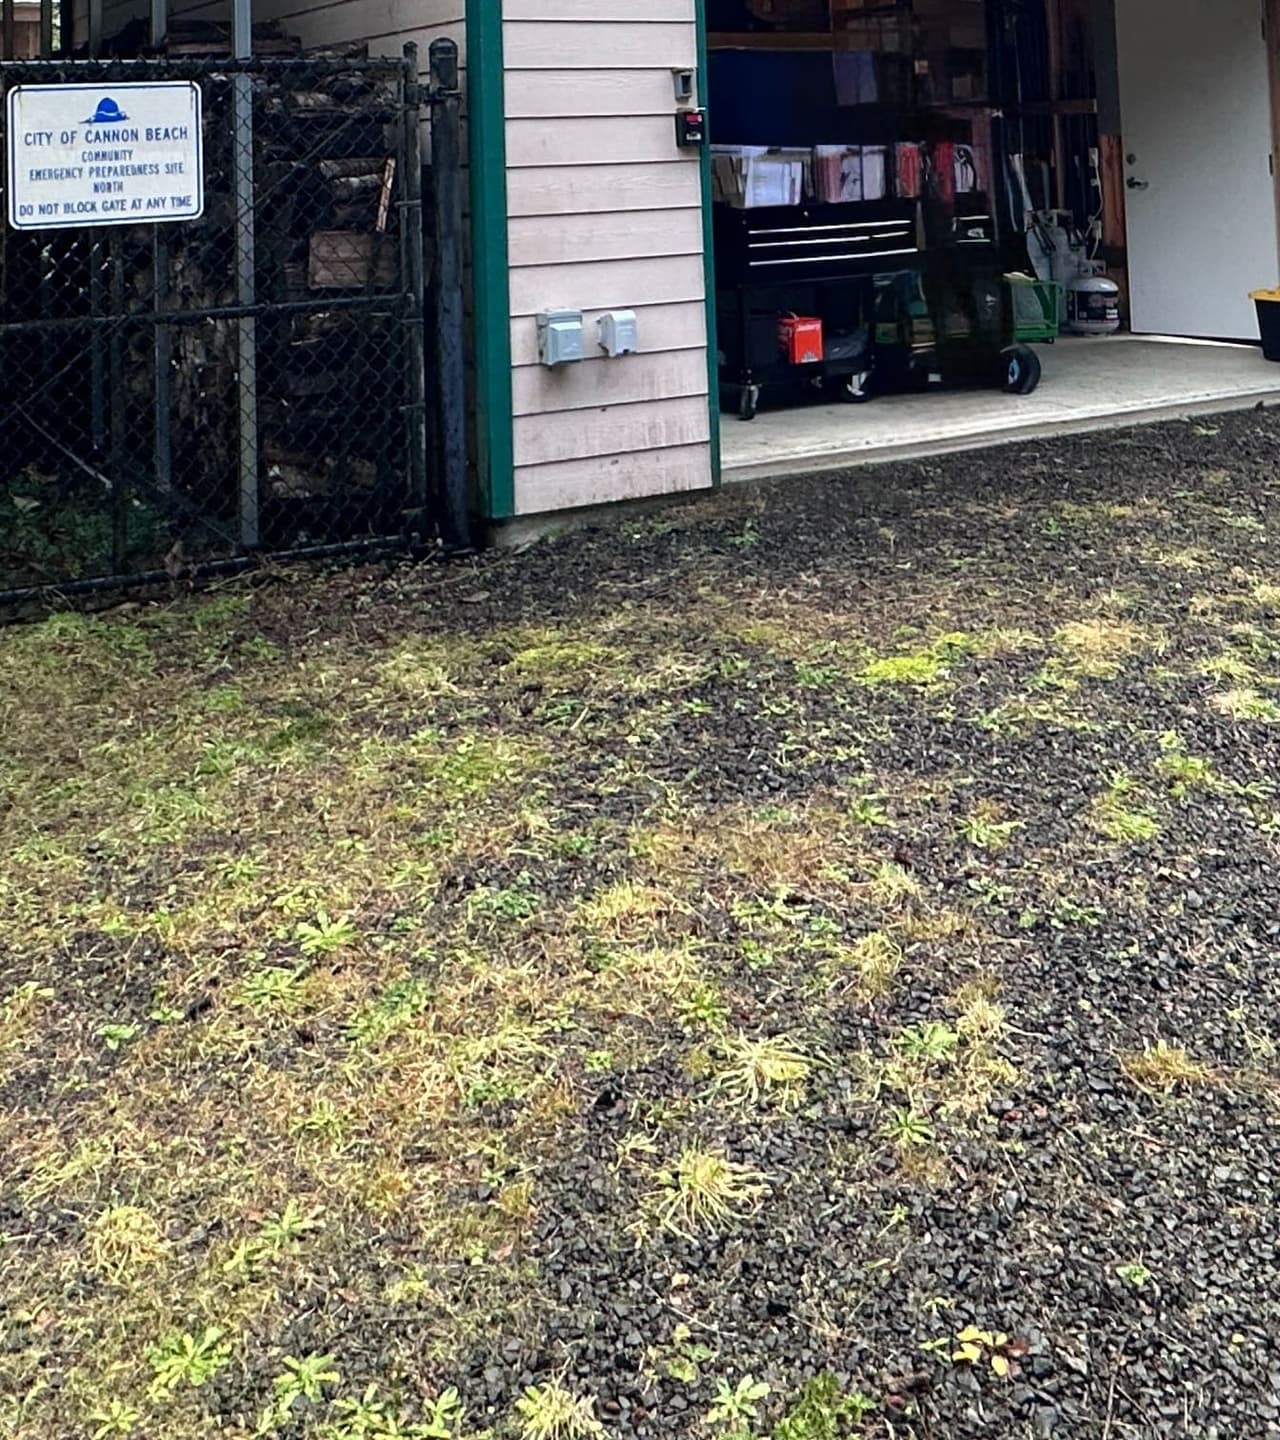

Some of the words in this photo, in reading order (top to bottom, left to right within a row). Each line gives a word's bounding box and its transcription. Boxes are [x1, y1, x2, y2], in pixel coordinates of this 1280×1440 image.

[24, 132, 53, 146] CITY
[60, 131, 77, 145] OF
[85, 128, 139, 143] CANNON
[145, 126, 188, 141] BEACH
[81, 150, 133, 162] COMMUNITY
[29, 168, 83, 181] EMERGENCY
[88, 164, 160, 178] PREPAREDNESS
[165, 162, 184, 174] SITE
[93, 181, 124, 193] NORTH
[19, 204, 33, 216] DO
[38, 203, 59, 215] NOT
[64, 201, 97, 213] BLOCK
[101, 199, 126, 211] GATE
[130, 198, 142, 210] AT
[146, 197, 166, 209] ANY
[171, 195, 193, 207] TIME
